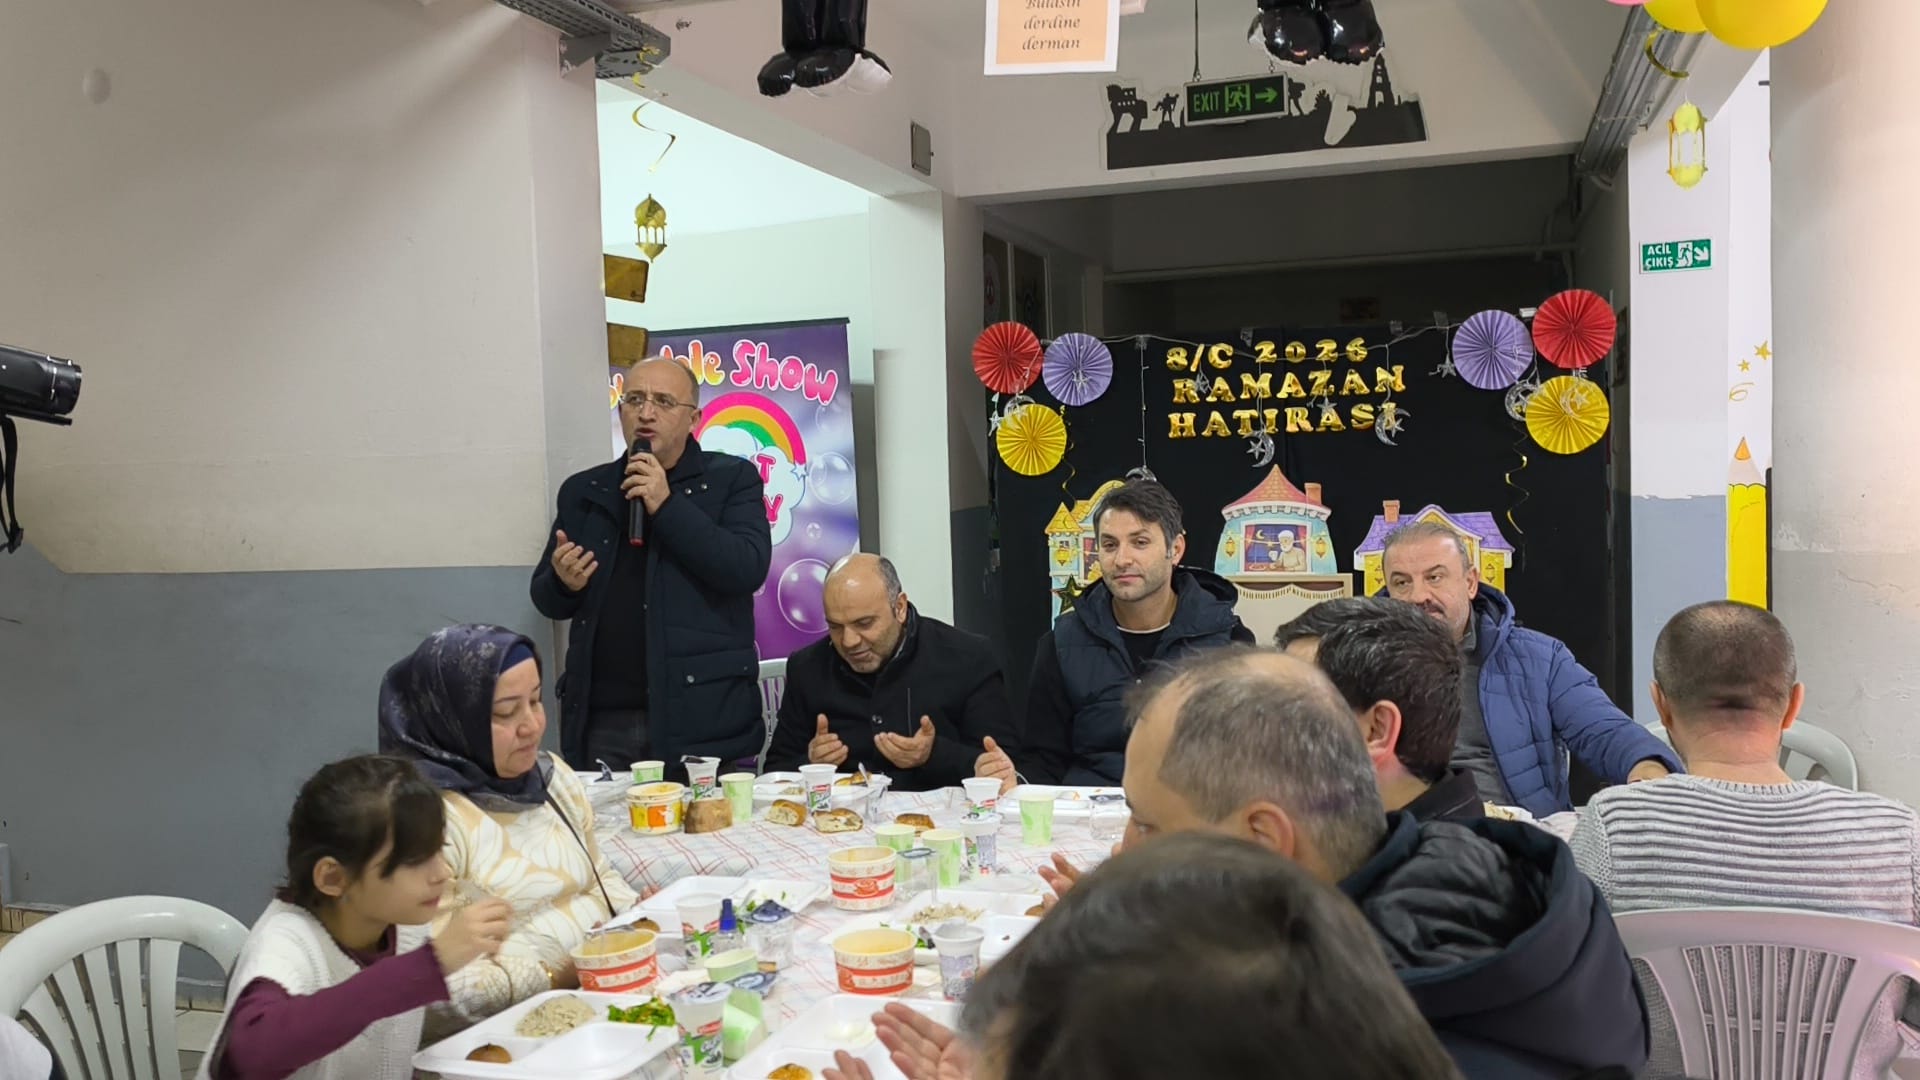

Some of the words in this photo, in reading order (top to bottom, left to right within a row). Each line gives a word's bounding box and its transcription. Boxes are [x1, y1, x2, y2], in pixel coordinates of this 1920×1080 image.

[1023, 14, 1081, 30] derdine
[1022, 35, 1080, 51] derman
[1193, 91, 1220, 112] EXIT
[1645, 256, 1674, 270] ÇIKIŞ
[1166, 343, 1234, 373] 8/C
[1254, 337, 1368, 363] 2026
[730, 339, 838, 406] Show
[1172, 364, 1406, 403] RAMAZAN
[1168, 402, 1397, 438] HATIRASI
